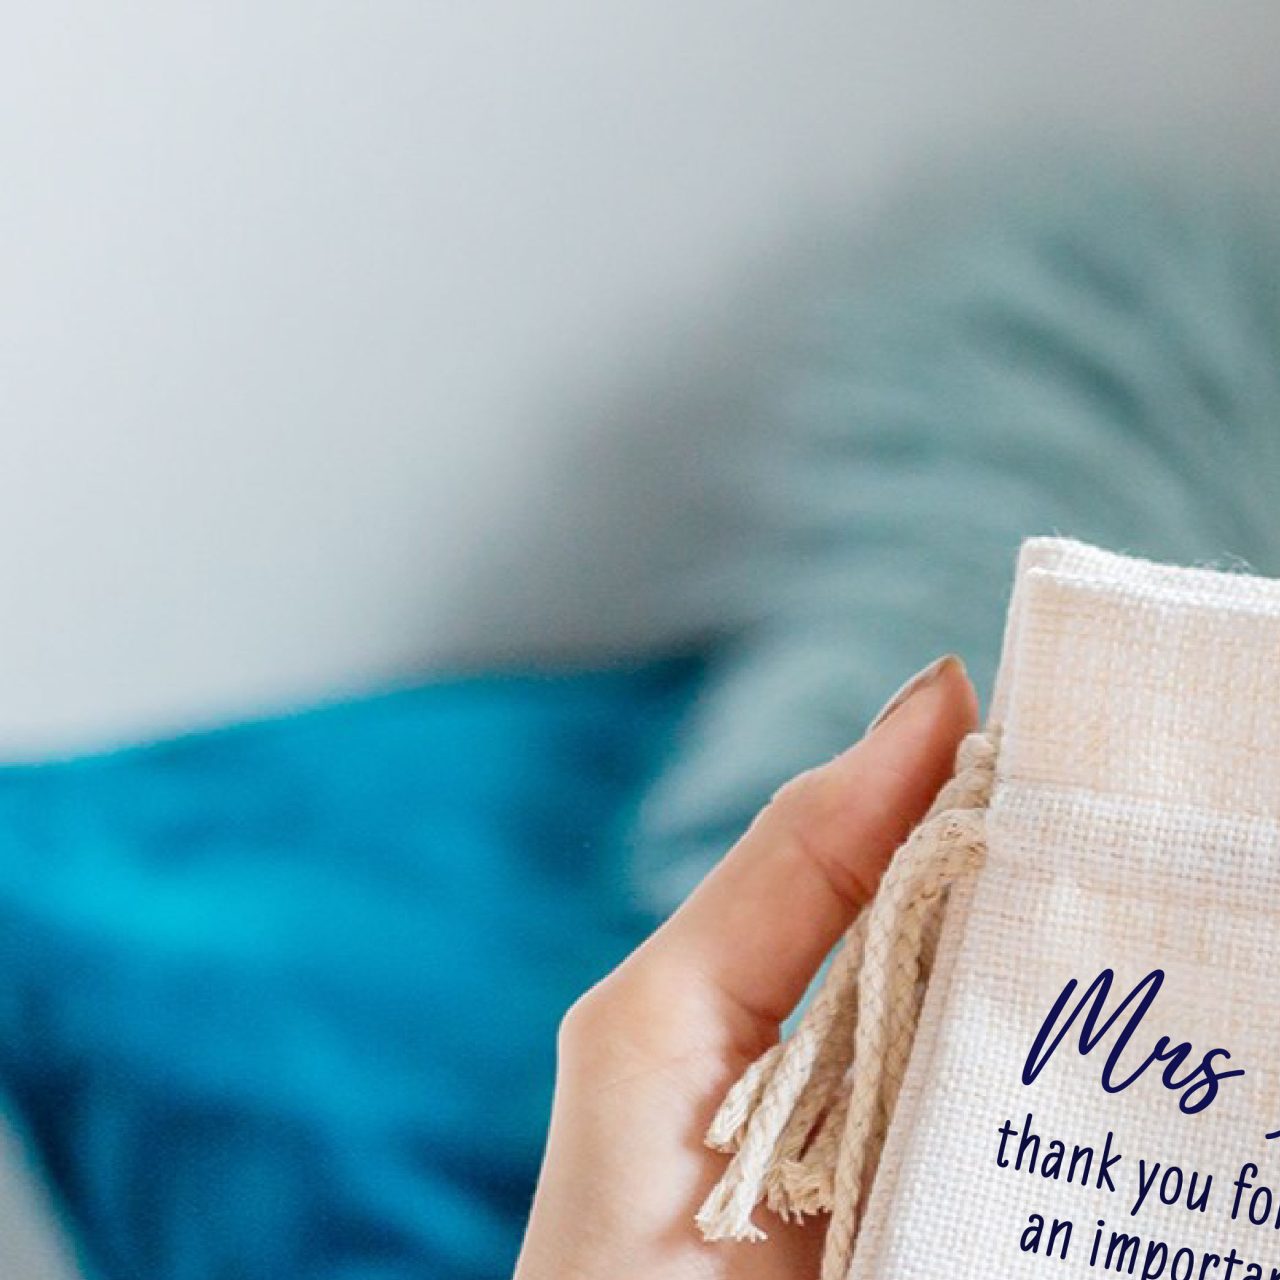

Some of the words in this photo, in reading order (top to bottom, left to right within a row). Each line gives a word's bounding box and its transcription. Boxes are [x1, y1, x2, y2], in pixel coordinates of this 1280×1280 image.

[1021, 968, 1246, 1115] Mrs
[996, 1112, 1122, 1193] thank
[1130, 1158, 1213, 1217] you
[1019, 1213, 1073, 1260] an
